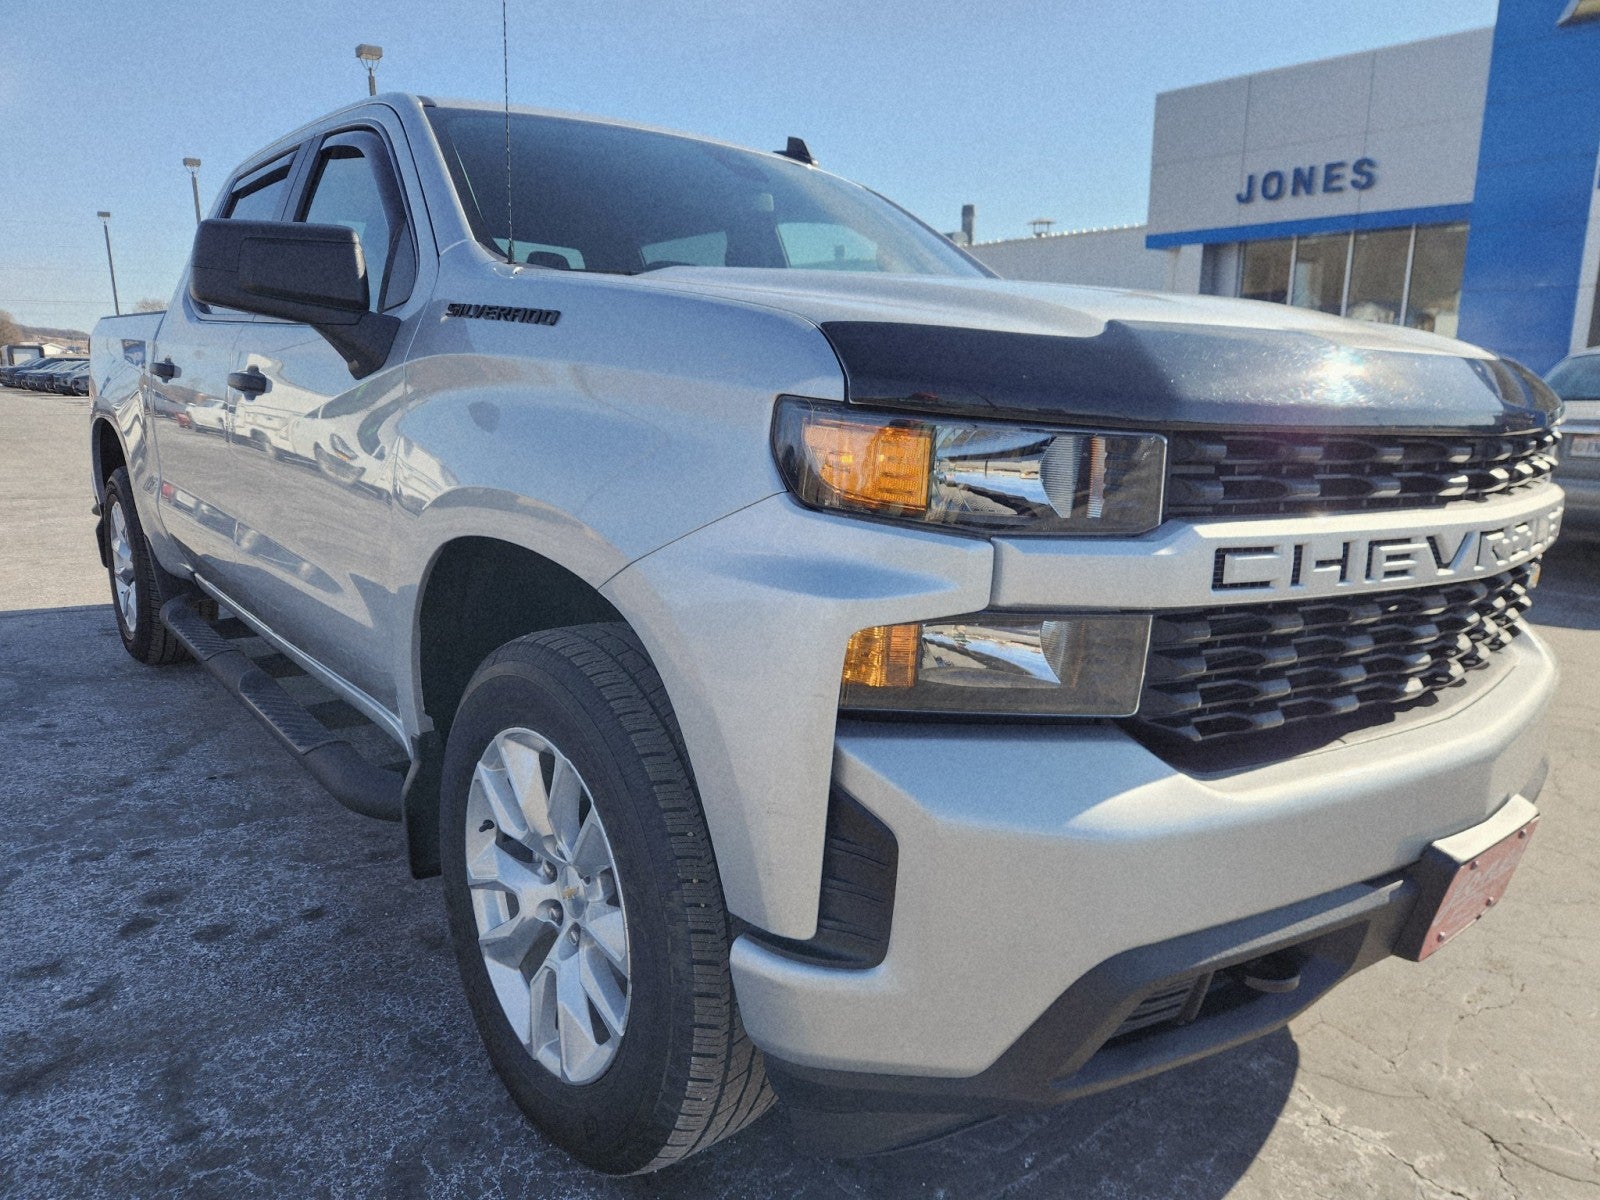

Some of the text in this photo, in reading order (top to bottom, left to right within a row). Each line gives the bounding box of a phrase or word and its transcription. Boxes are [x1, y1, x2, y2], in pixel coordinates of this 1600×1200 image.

[1236, 156, 1376, 204] JONES
[445, 303, 561, 326] SILVERADO
[1211, 506, 1563, 592] CHEVROLE
